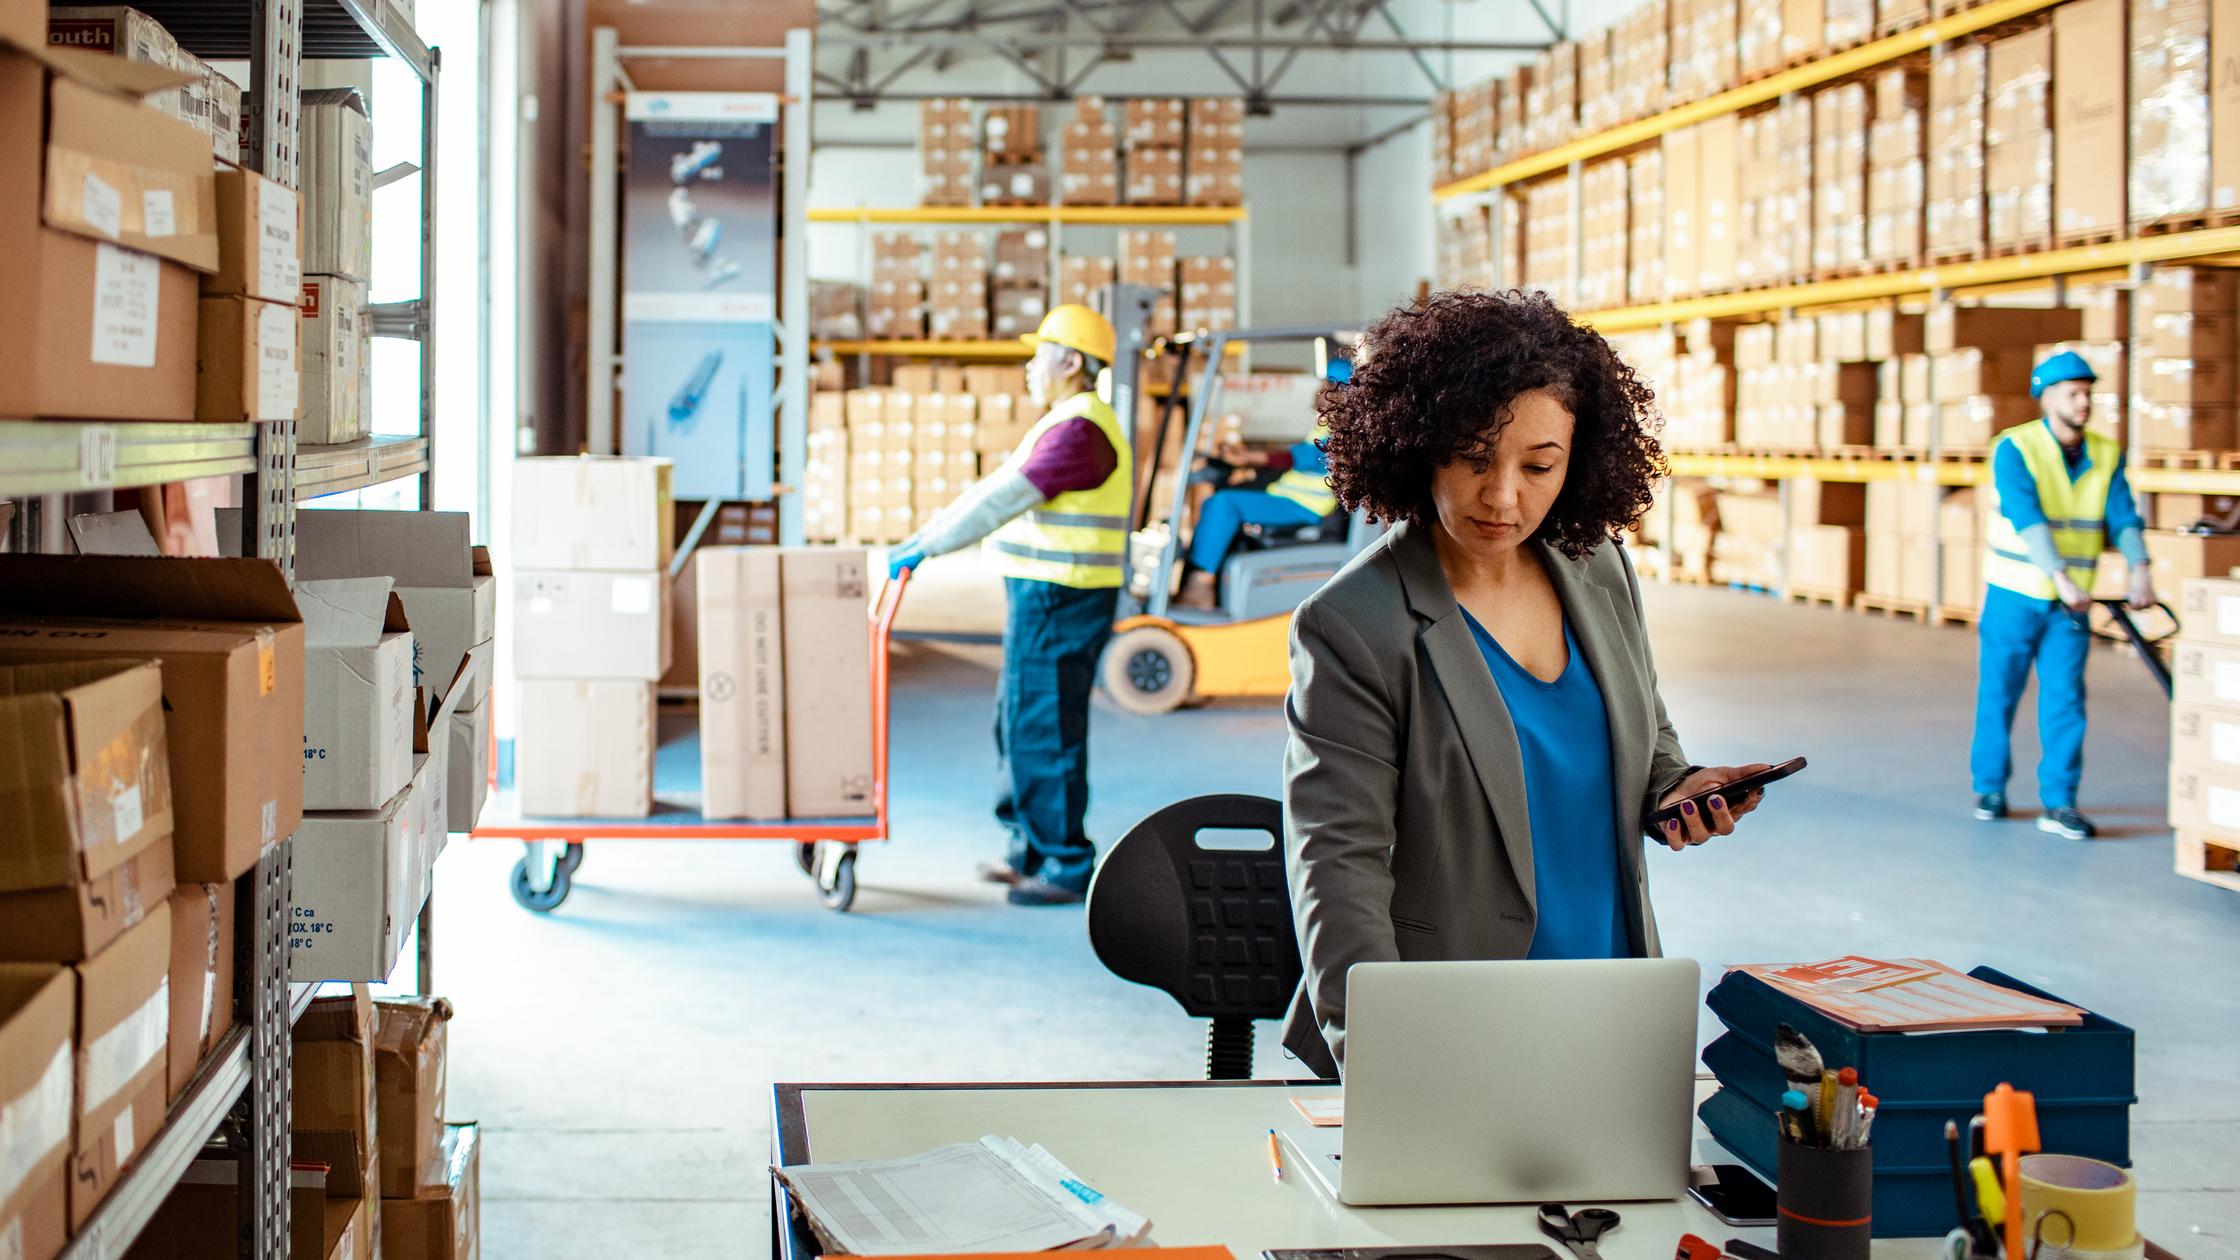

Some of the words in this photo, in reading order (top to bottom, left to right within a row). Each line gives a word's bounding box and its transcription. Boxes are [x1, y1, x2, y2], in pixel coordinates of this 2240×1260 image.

[304, 909, 315, 917] ca
[326, 923, 333, 933] C
[305, 938, 312, 949] C
